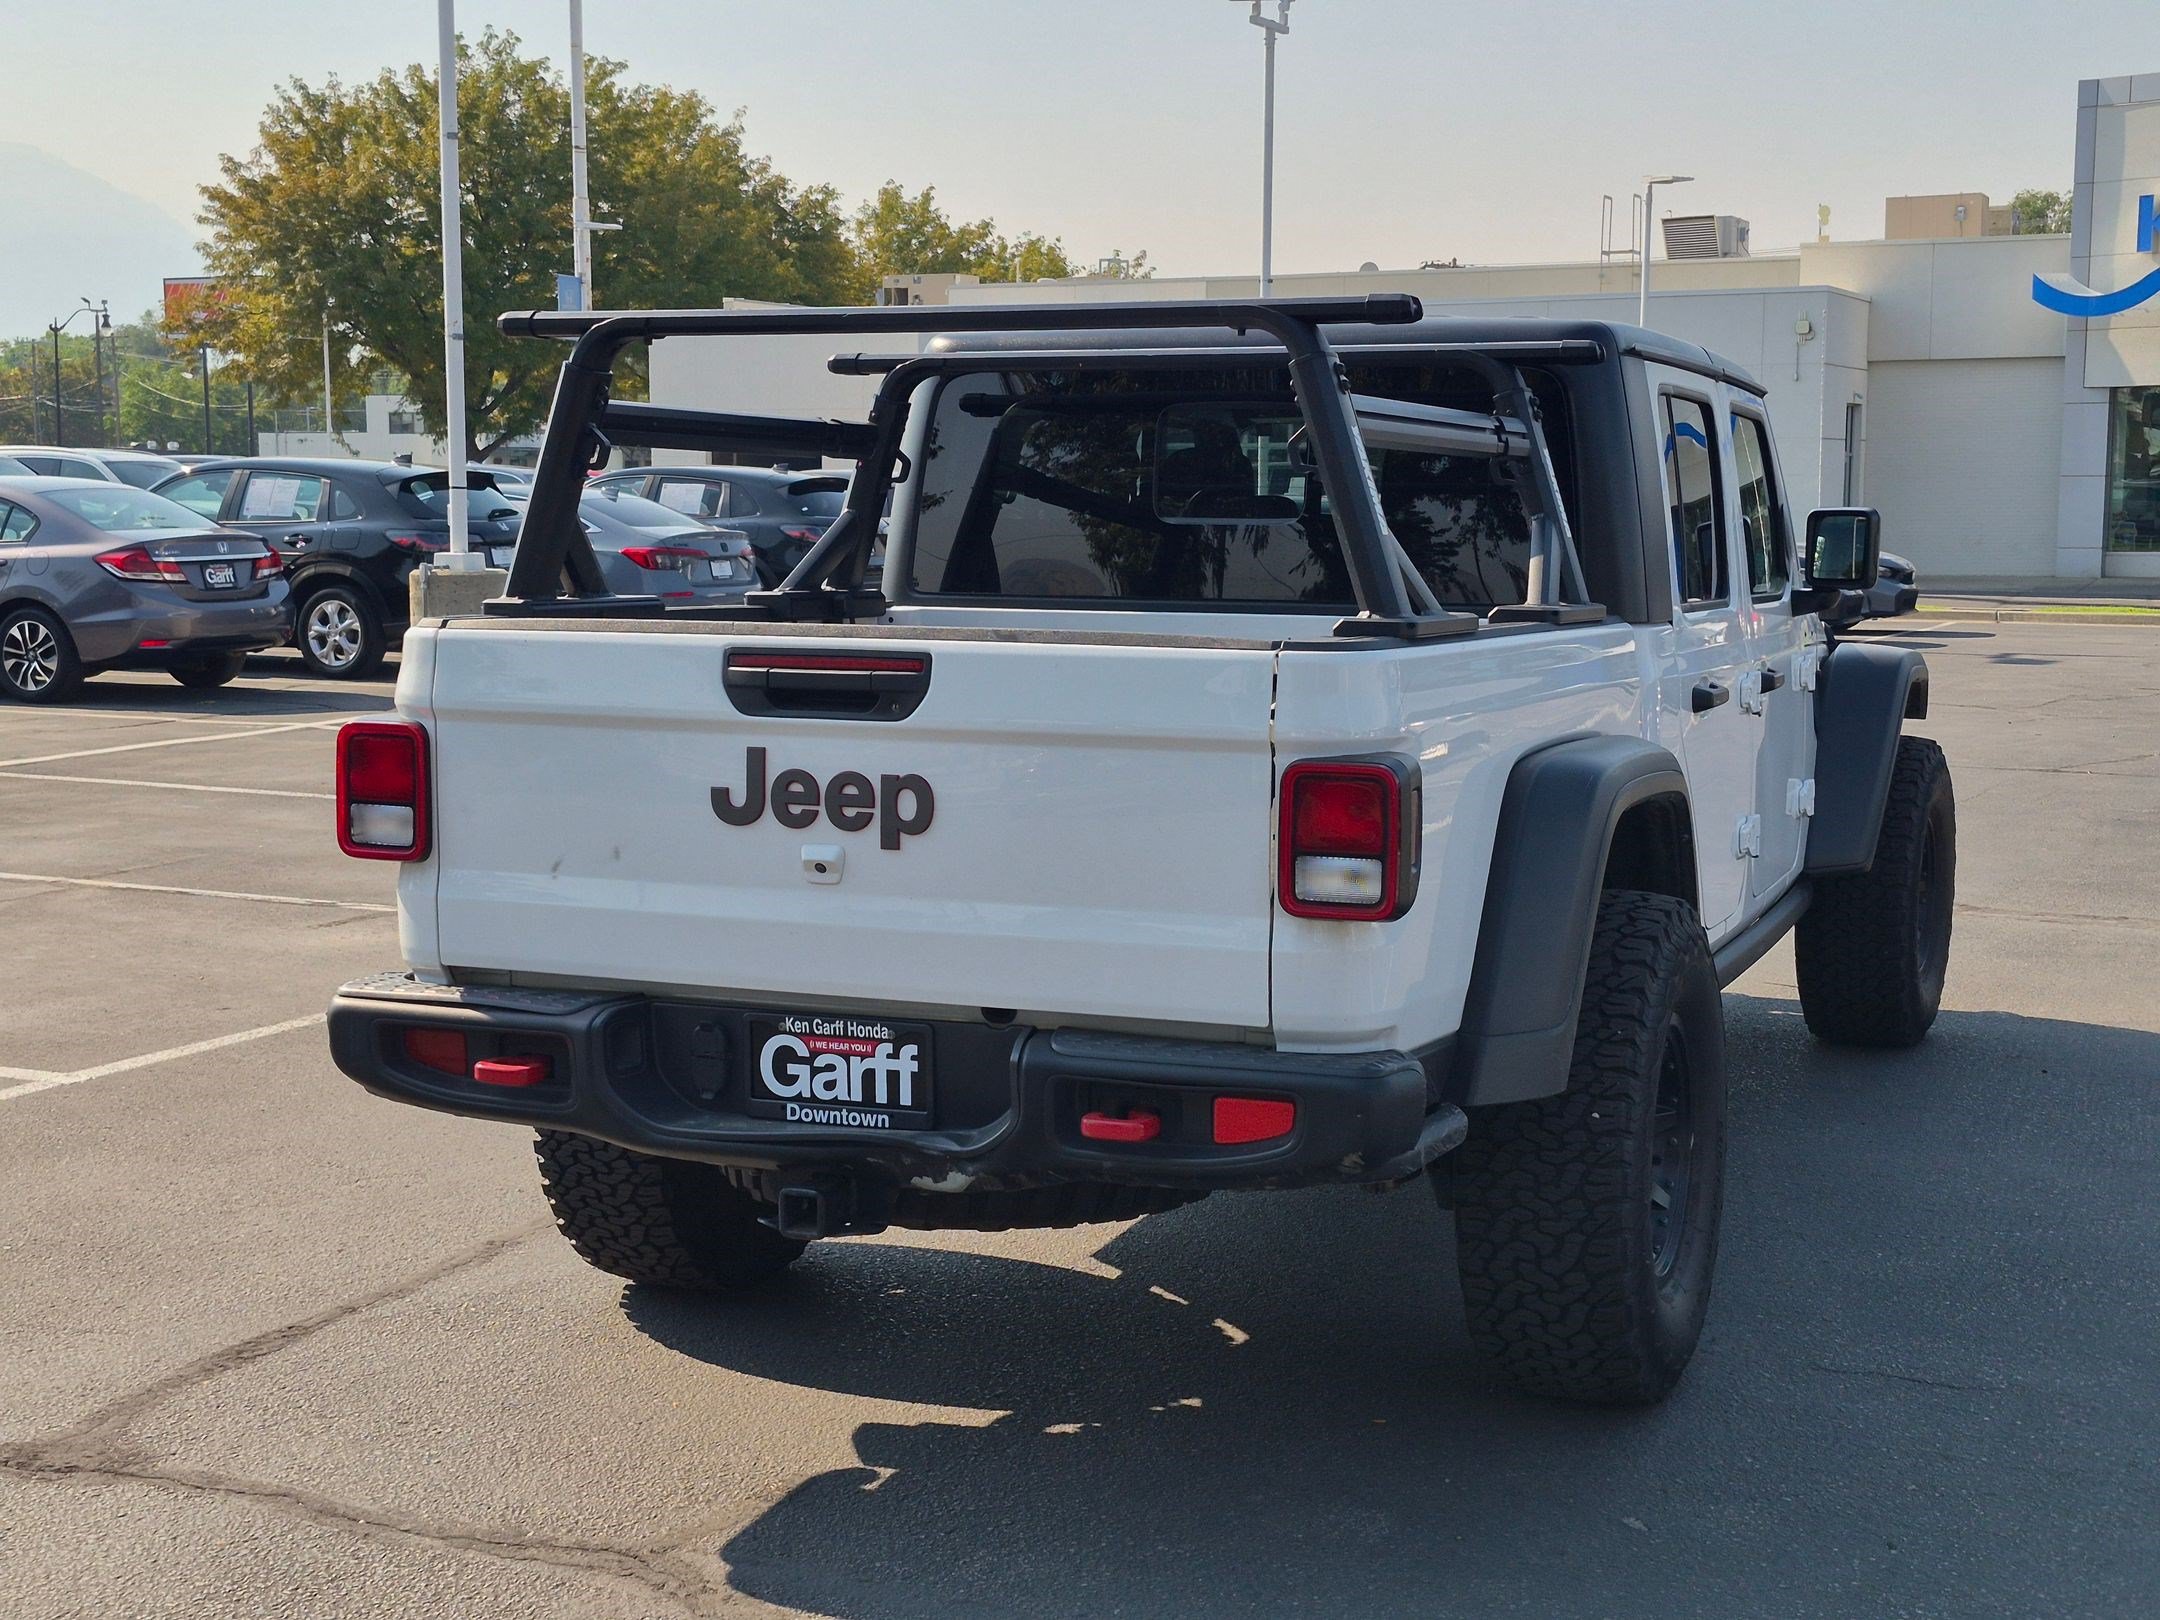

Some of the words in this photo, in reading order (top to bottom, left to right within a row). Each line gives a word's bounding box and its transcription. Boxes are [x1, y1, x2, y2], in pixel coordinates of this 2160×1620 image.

[710, 746, 935, 850] Jeep
[785, 1017, 809, 1034] Ken
[813, 1018, 844, 1036] Garff
[848, 1021, 889, 1039] Honda
[815, 1040, 828, 1050] WE
[829, 1041, 850, 1051] HEAR
[851, 1043, 867, 1053] YOU
[760, 1034, 918, 1106] Garff
[786, 1104, 889, 1128] Downtown
